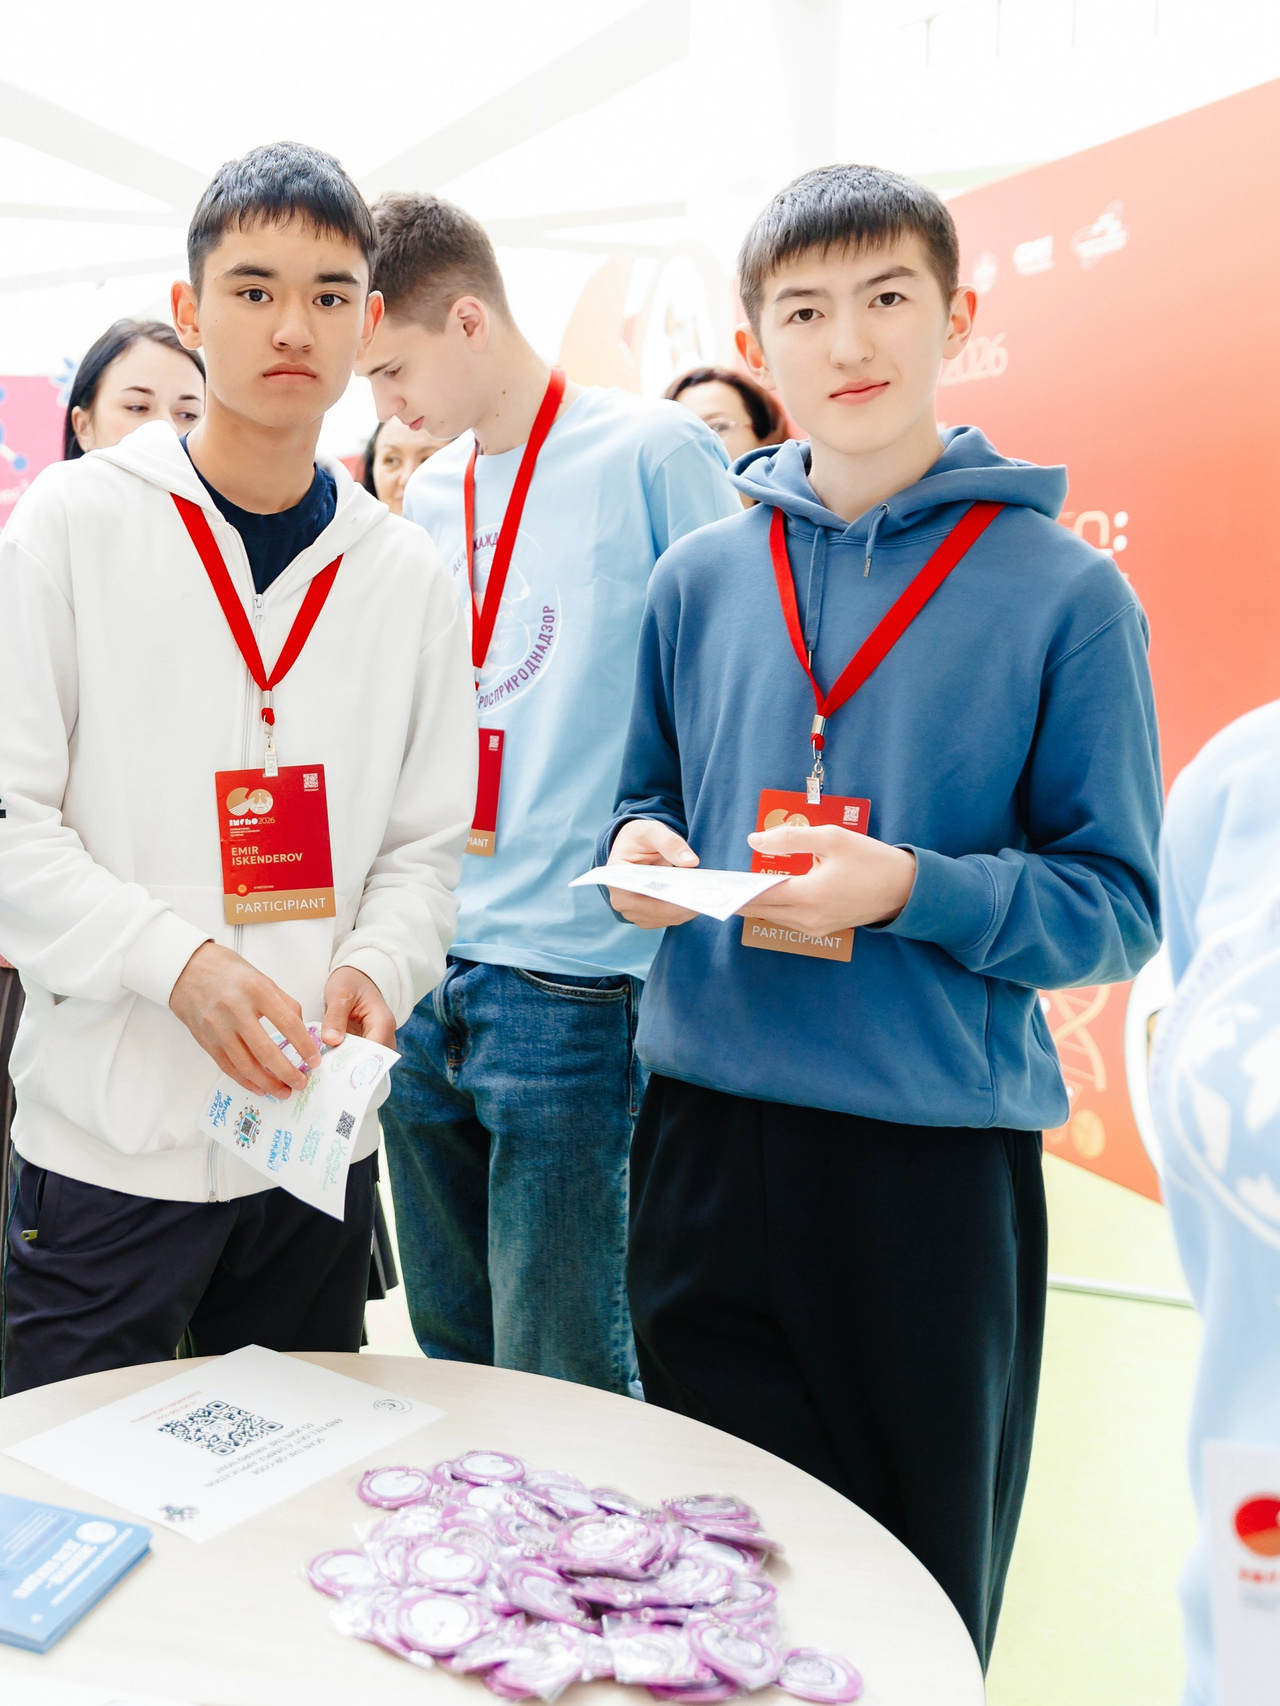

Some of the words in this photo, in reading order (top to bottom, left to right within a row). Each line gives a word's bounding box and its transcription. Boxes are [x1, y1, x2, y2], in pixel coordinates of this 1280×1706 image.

[478, 605, 555, 709] РОСПРИРОДНАДЗОР
[231, 846, 259, 856] EMIR
[232, 852, 303, 866] ISKENDEROV
[235, 897, 326, 914] PARTICIPIANT
[751, 925, 842, 949] PARTICIPIANT
[301, 1422, 315, 1430] TO
[325, 1417, 344, 1428] AND
[283, 1428, 301, 1439] JOIN
[310, 1426, 327, 1435] FILL
[269, 1438, 285, 1447] THE
[293, 1434, 311, 1444] OUT
[289, 1448, 304, 1457] THE
